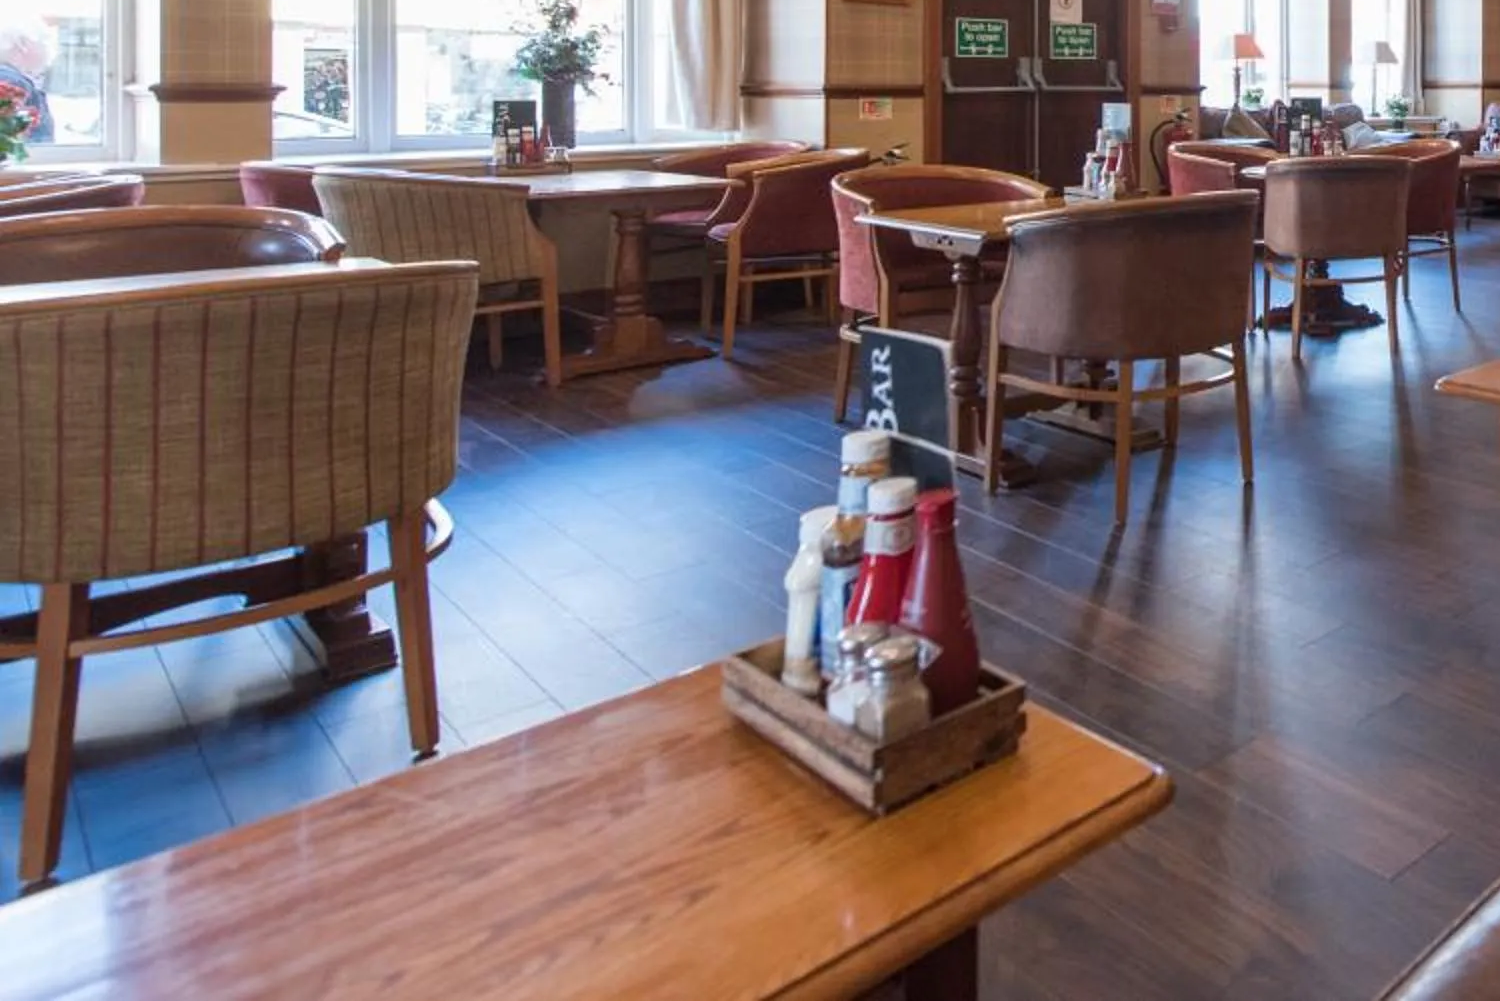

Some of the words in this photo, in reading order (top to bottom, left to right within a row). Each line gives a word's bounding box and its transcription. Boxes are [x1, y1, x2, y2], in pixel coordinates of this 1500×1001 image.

[961, 22, 984, 33] Push
[987, 22, 1003, 32] bar
[1055, 26, 1077, 36] Push
[964, 33, 975, 41] to
[976, 34, 1001, 43] open
[866, 345, 899, 433] BAR
